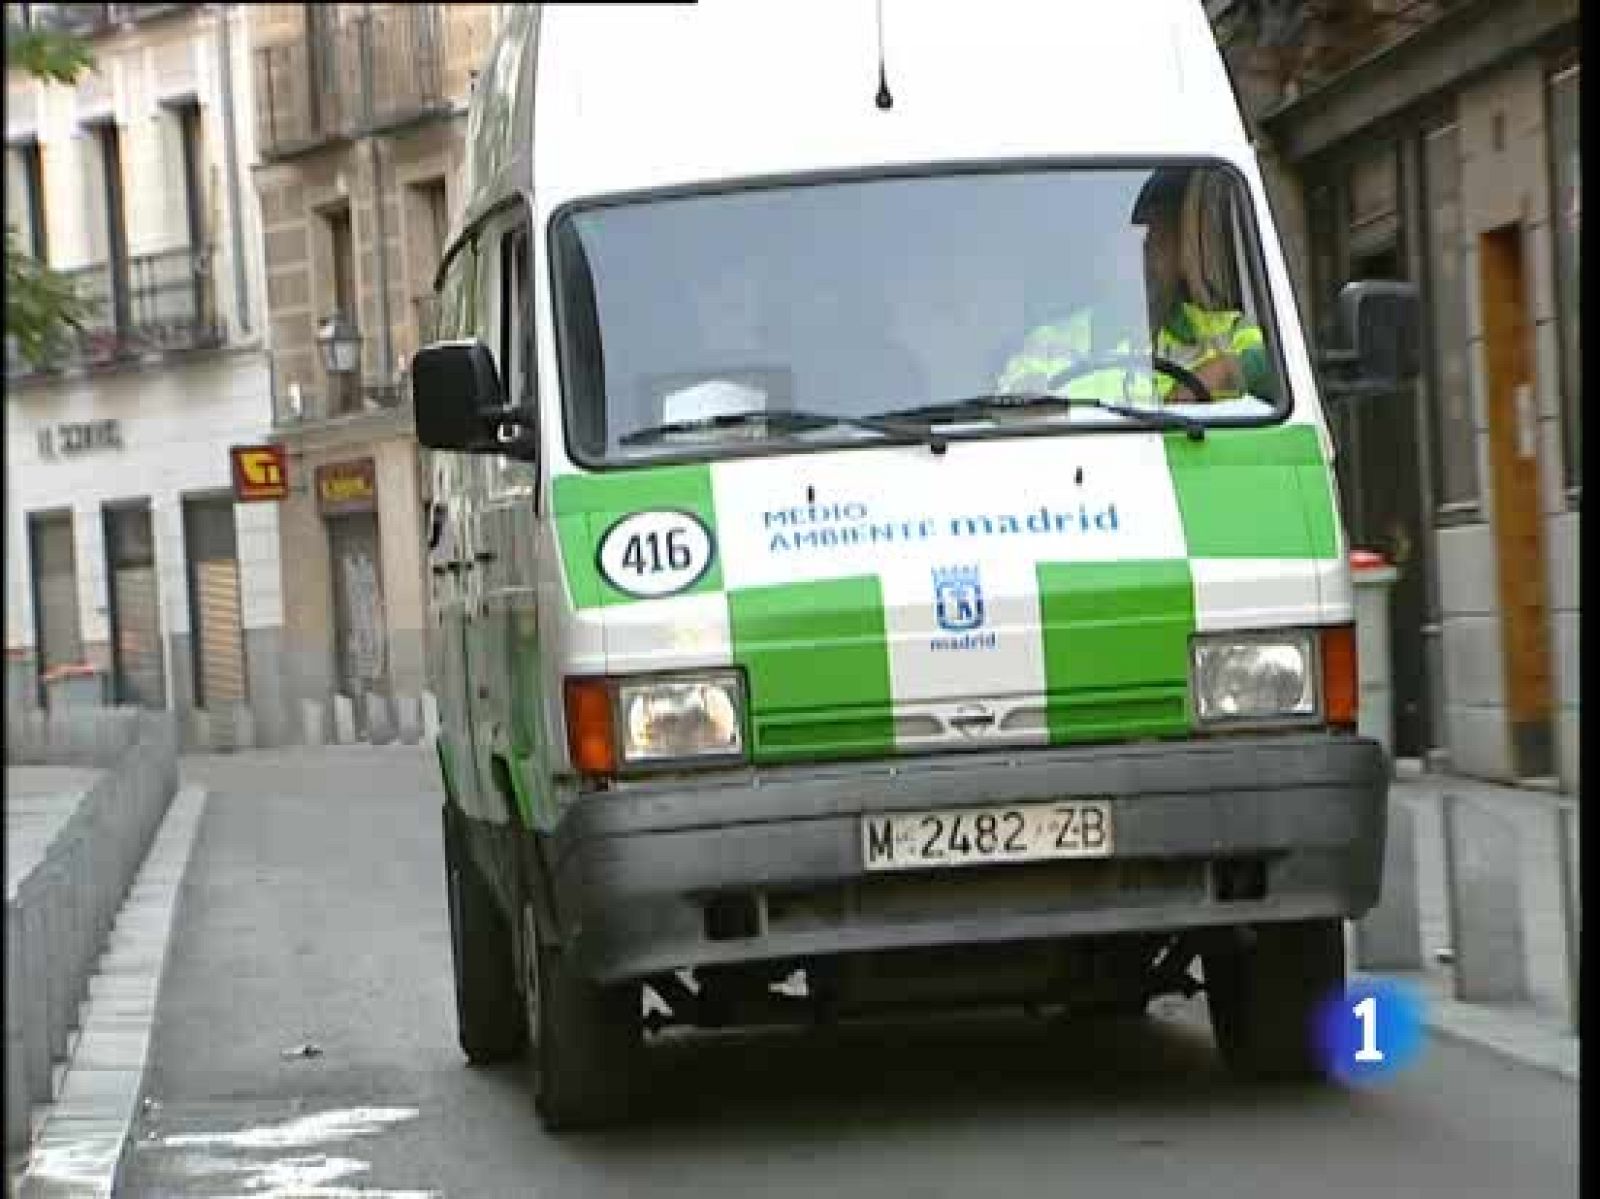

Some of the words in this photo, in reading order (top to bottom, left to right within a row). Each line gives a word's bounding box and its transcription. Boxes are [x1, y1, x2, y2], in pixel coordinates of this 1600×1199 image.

[763, 503, 867, 529] MEDIO
[769, 518, 937, 551] AMBIENTE
[951, 504, 1120, 535] madrid
[621, 527, 693, 576] 416
[930, 632, 996, 652] madrid
